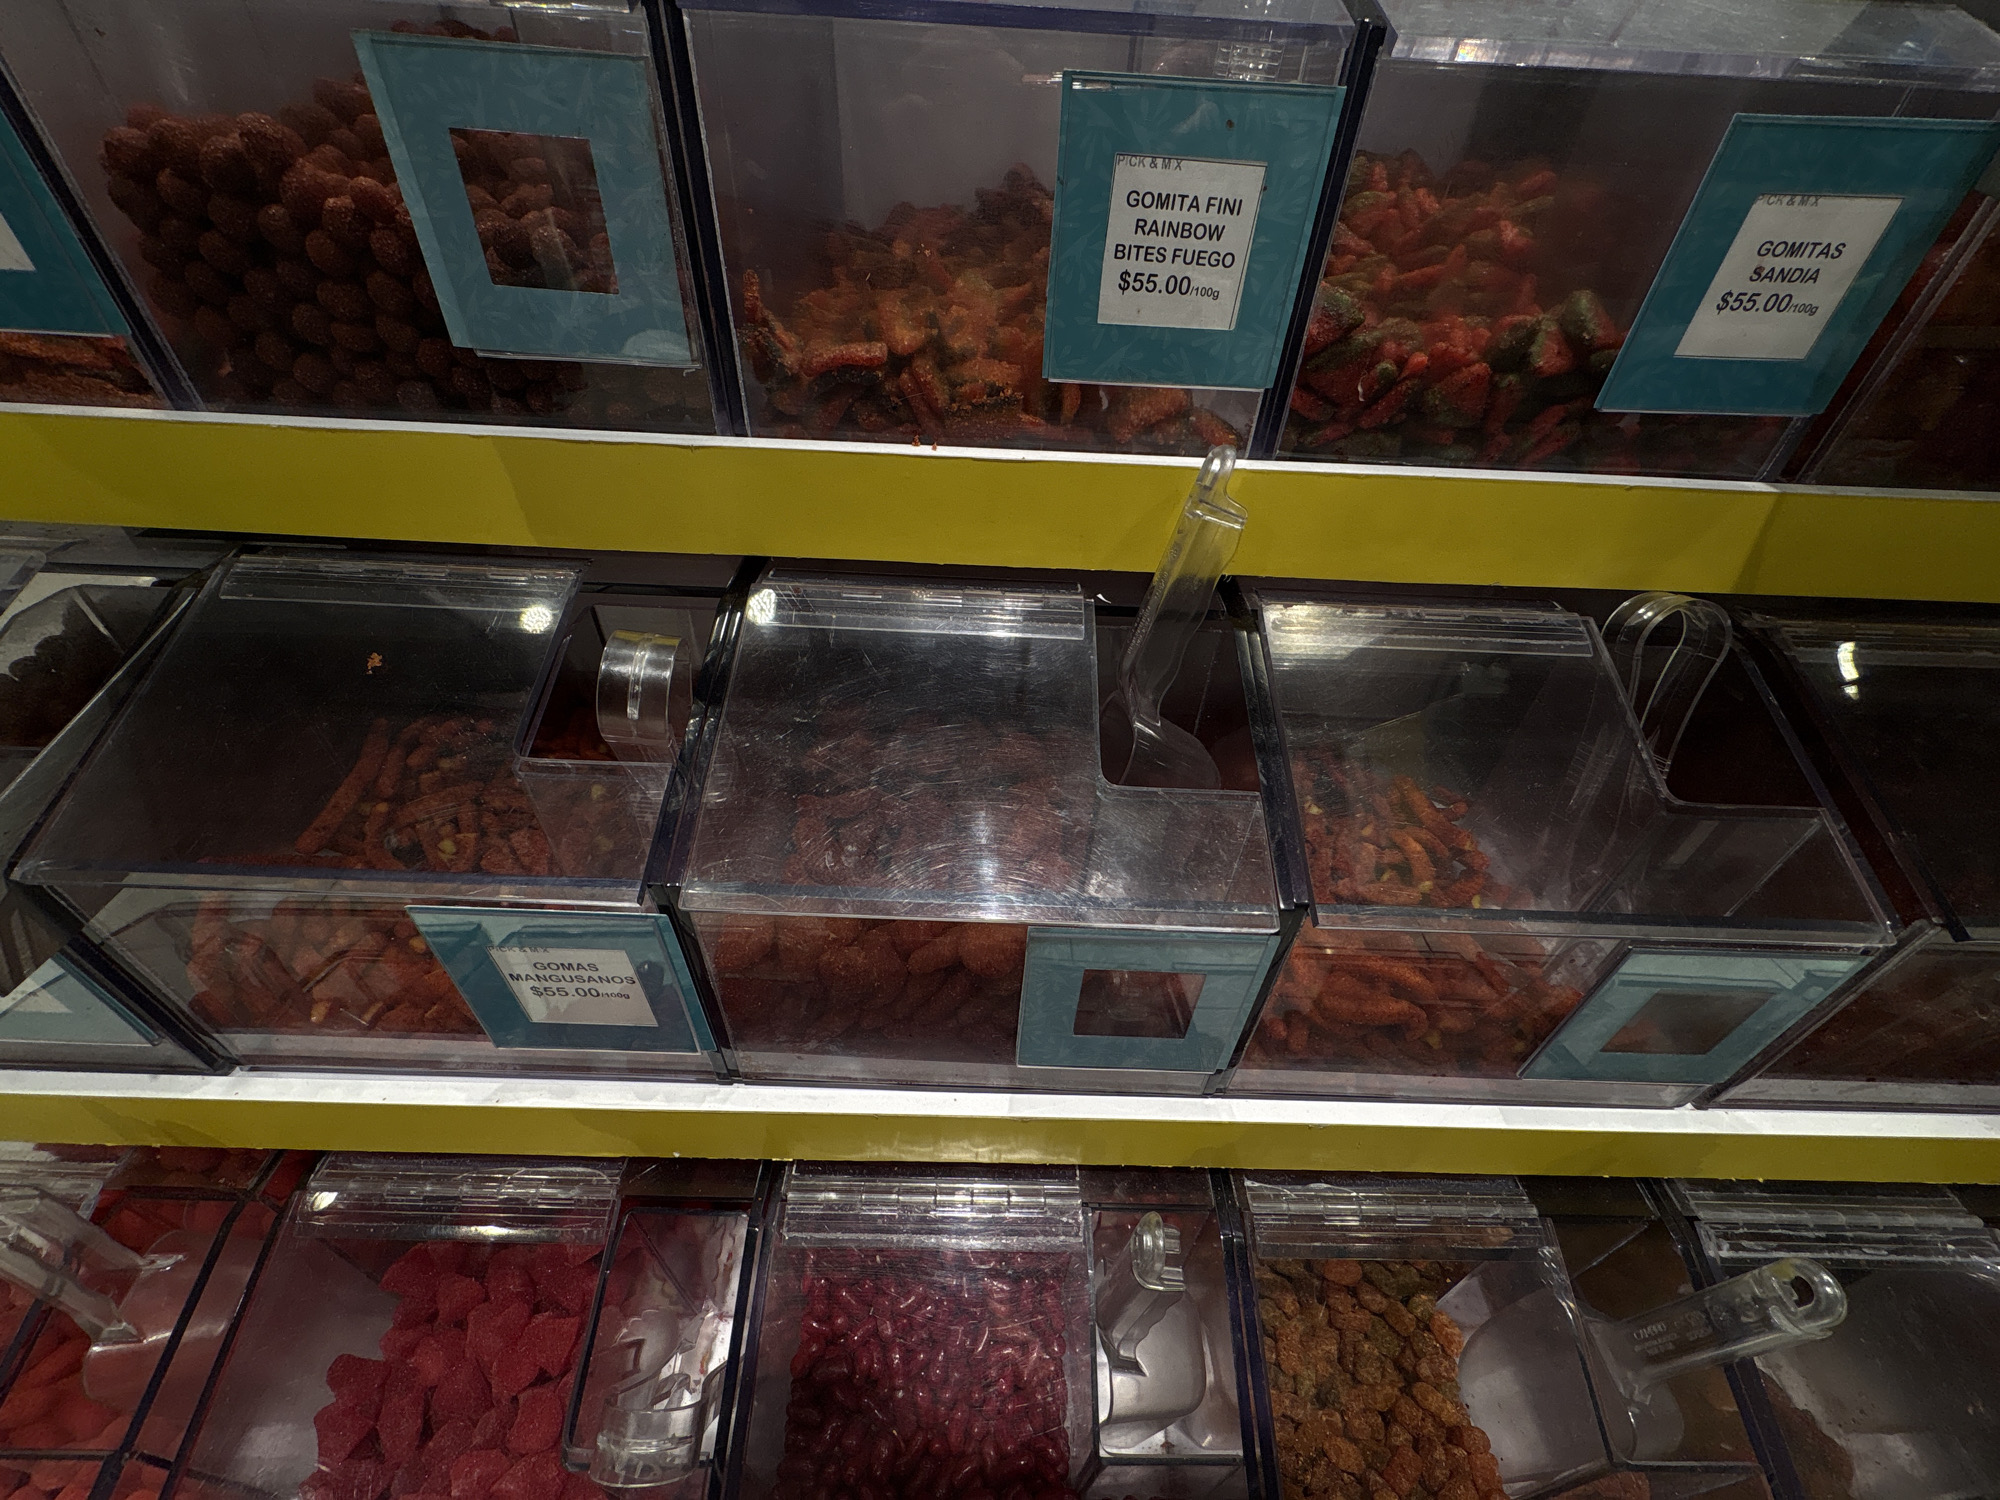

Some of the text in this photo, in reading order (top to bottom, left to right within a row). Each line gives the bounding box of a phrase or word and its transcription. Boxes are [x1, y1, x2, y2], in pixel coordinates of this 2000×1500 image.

[1149, 157, 1158, 169] &
[1126, 190, 1243, 217] GOMITA FINI
[1134, 218, 1226, 242] RAINBOW
[1113, 243, 1236, 269] BITES FUEGO
[1756, 240, 1847, 260] GOMITAS
[1749, 266, 1821, 284] SANDIA
[532, 961, 600, 972] GOMAS
[508, 972, 637, 985] MANGUSANOS
